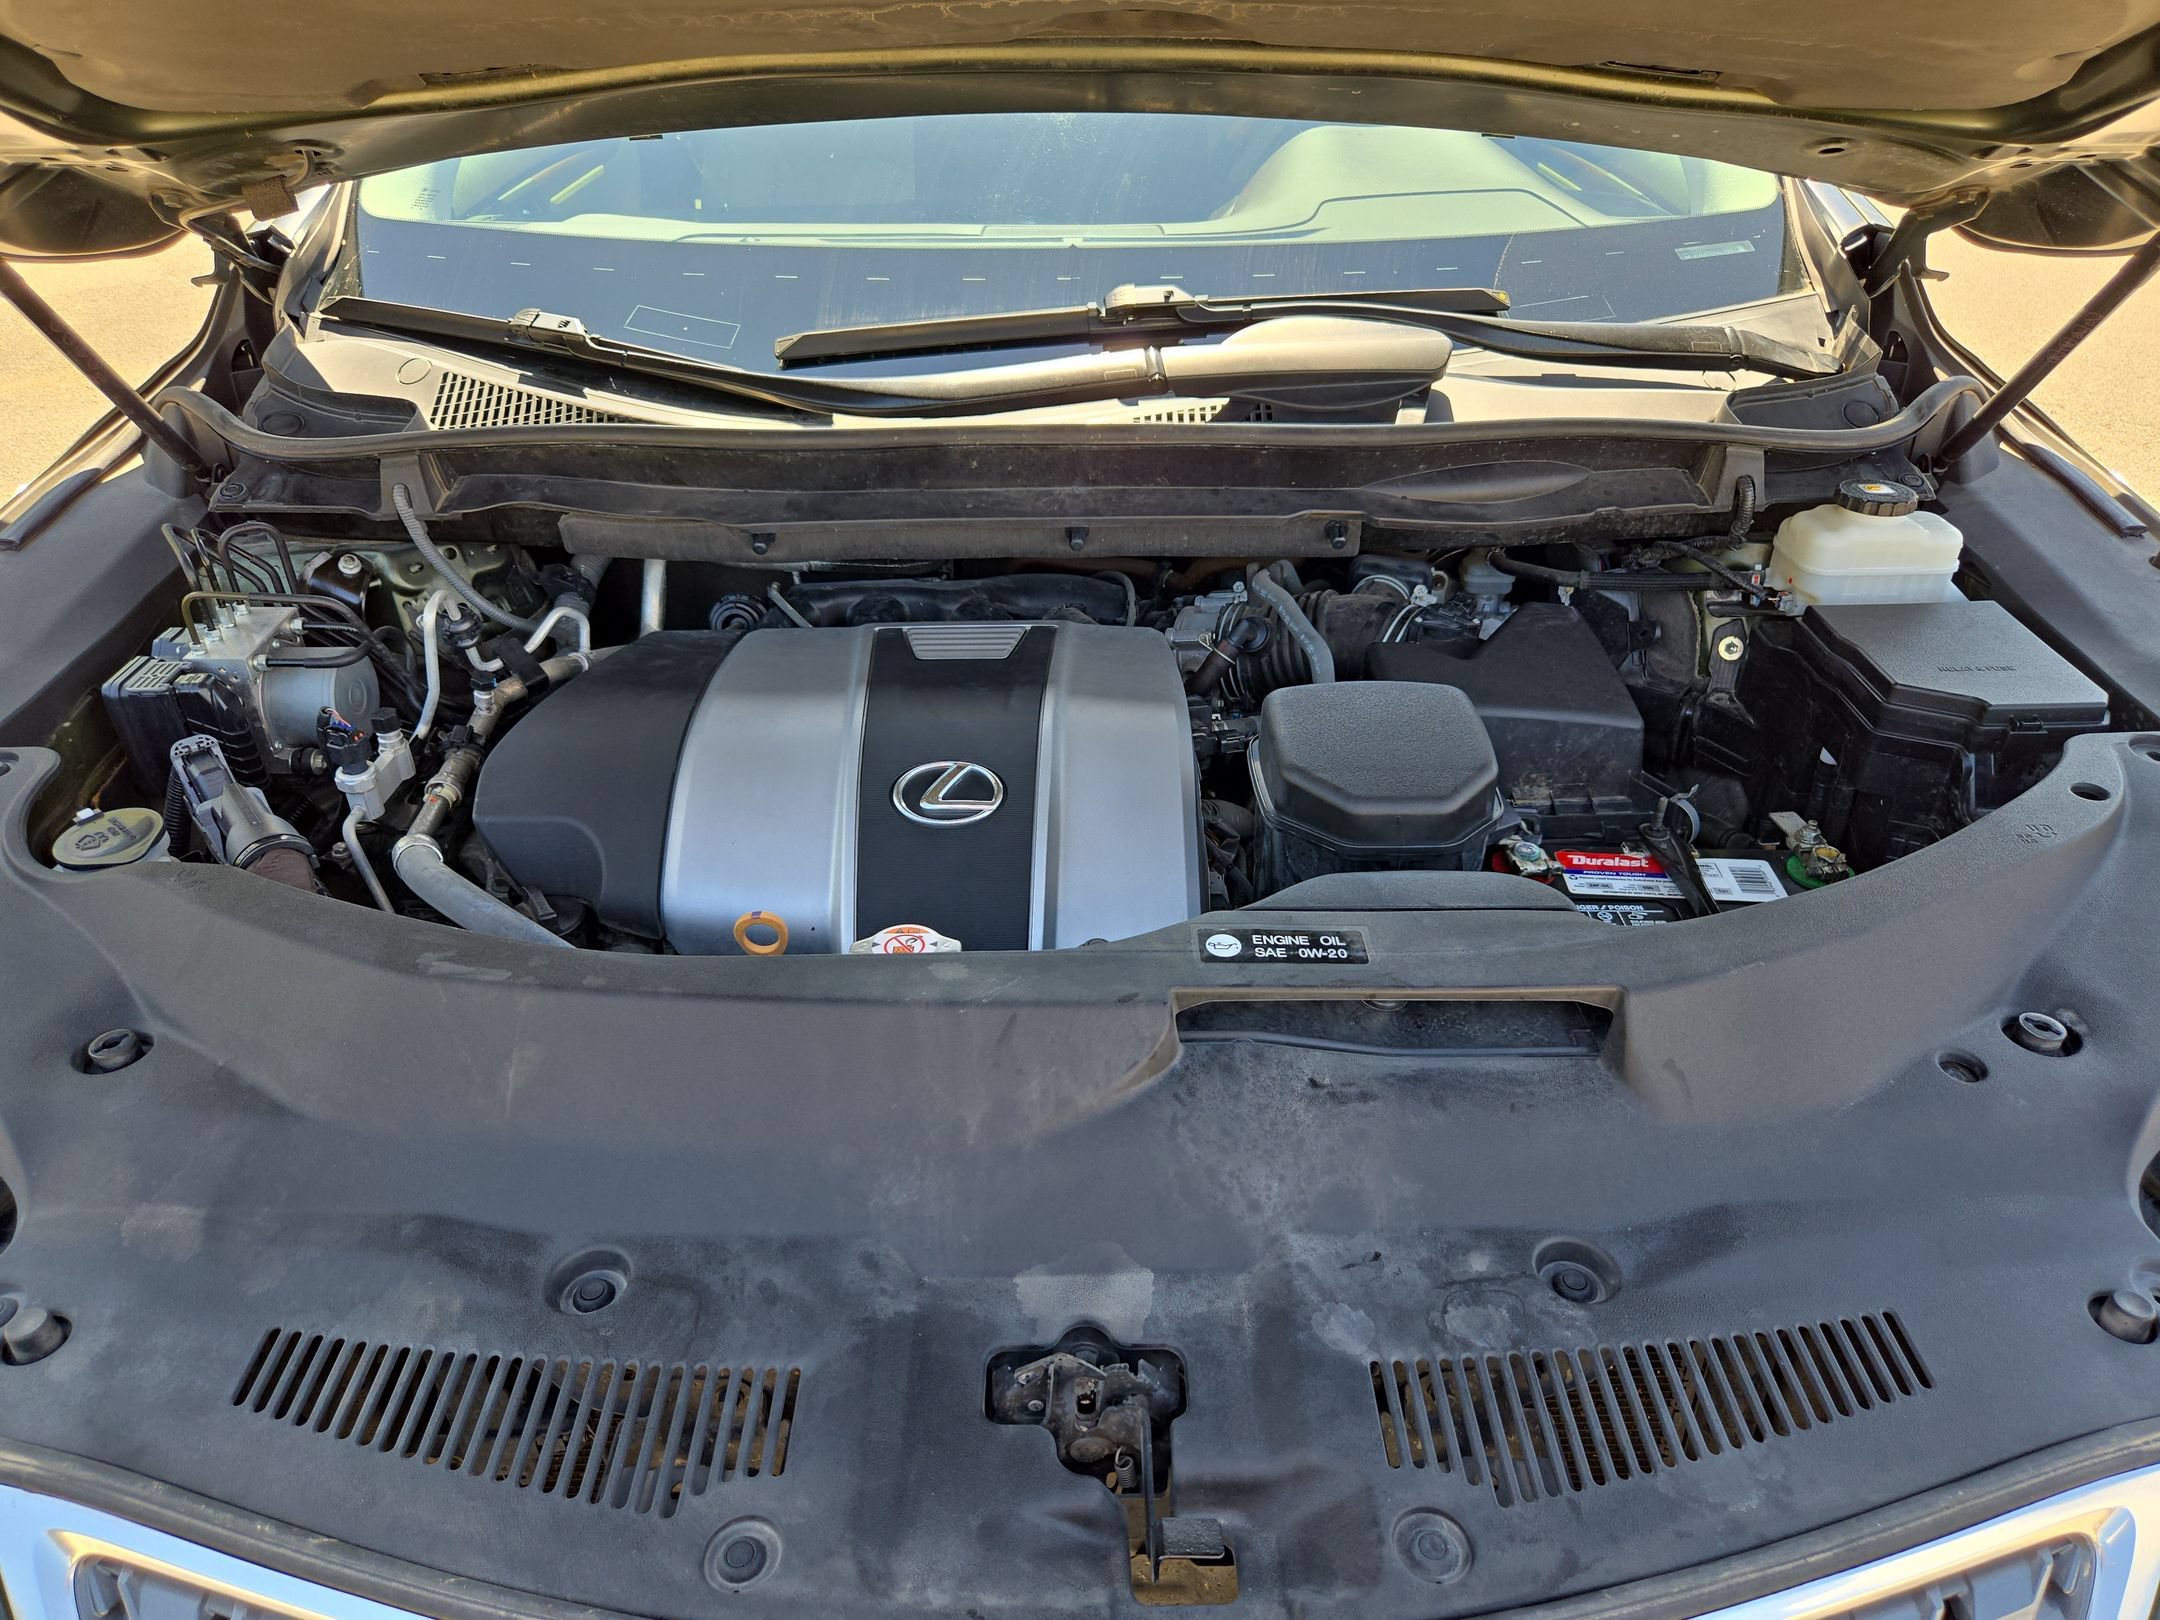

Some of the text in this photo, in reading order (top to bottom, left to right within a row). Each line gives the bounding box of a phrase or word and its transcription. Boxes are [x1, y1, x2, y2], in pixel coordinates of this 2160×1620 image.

[1567, 855, 1649, 867] Duralast
[1607, 904, 1644, 912] POISON
[1252, 934, 1347, 946] ENGINE OIL
[1254, 947, 1347, 959] SAE 0W-20
